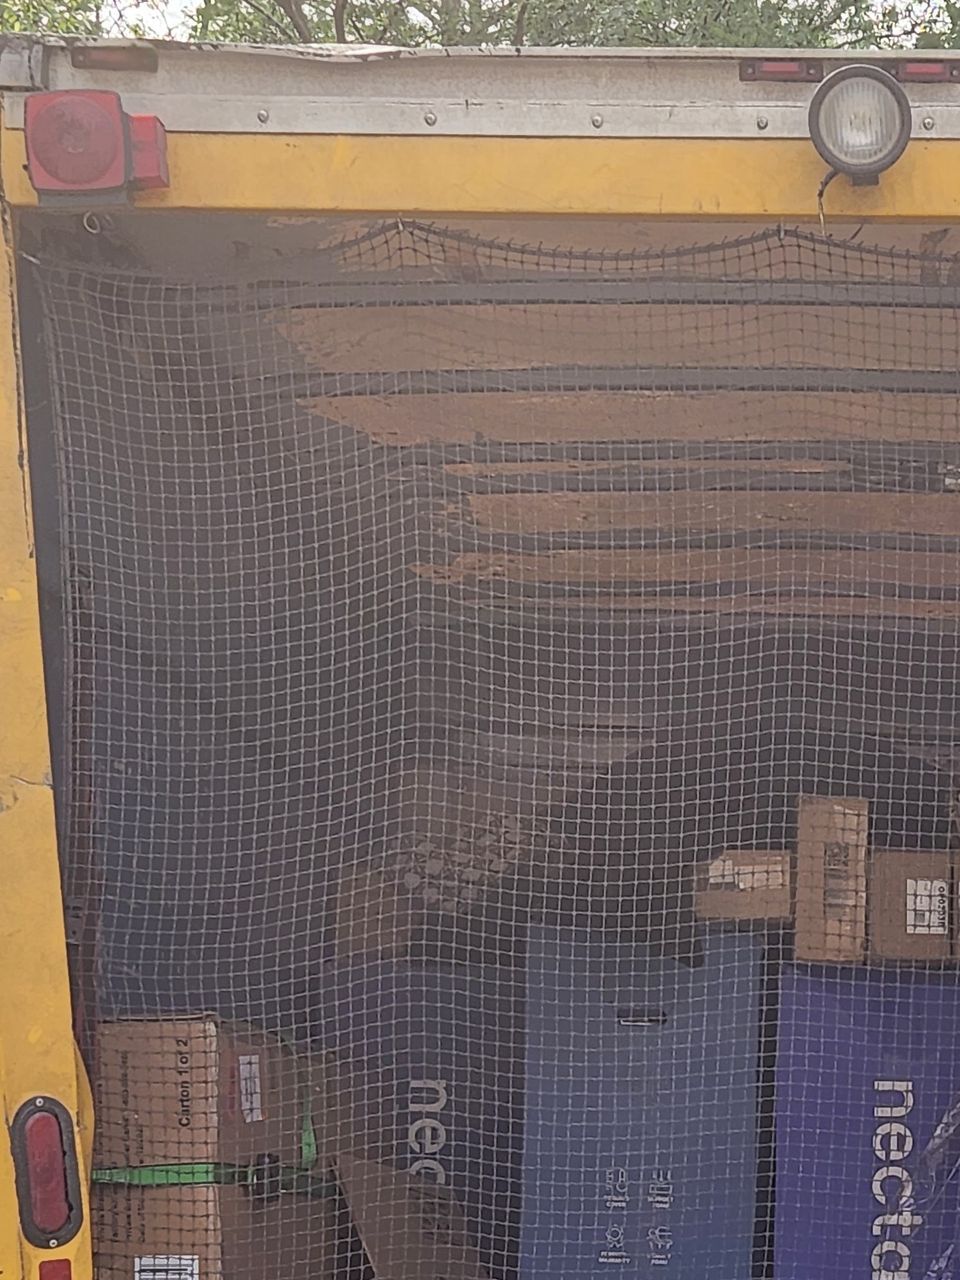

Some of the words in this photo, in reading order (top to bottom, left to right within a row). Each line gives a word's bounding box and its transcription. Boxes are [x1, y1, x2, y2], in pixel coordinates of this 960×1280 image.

[177, 1039, 189, 1047] 2
[177, 1051, 190, 1064] of
[178, 1080, 191, 1127] Carton
